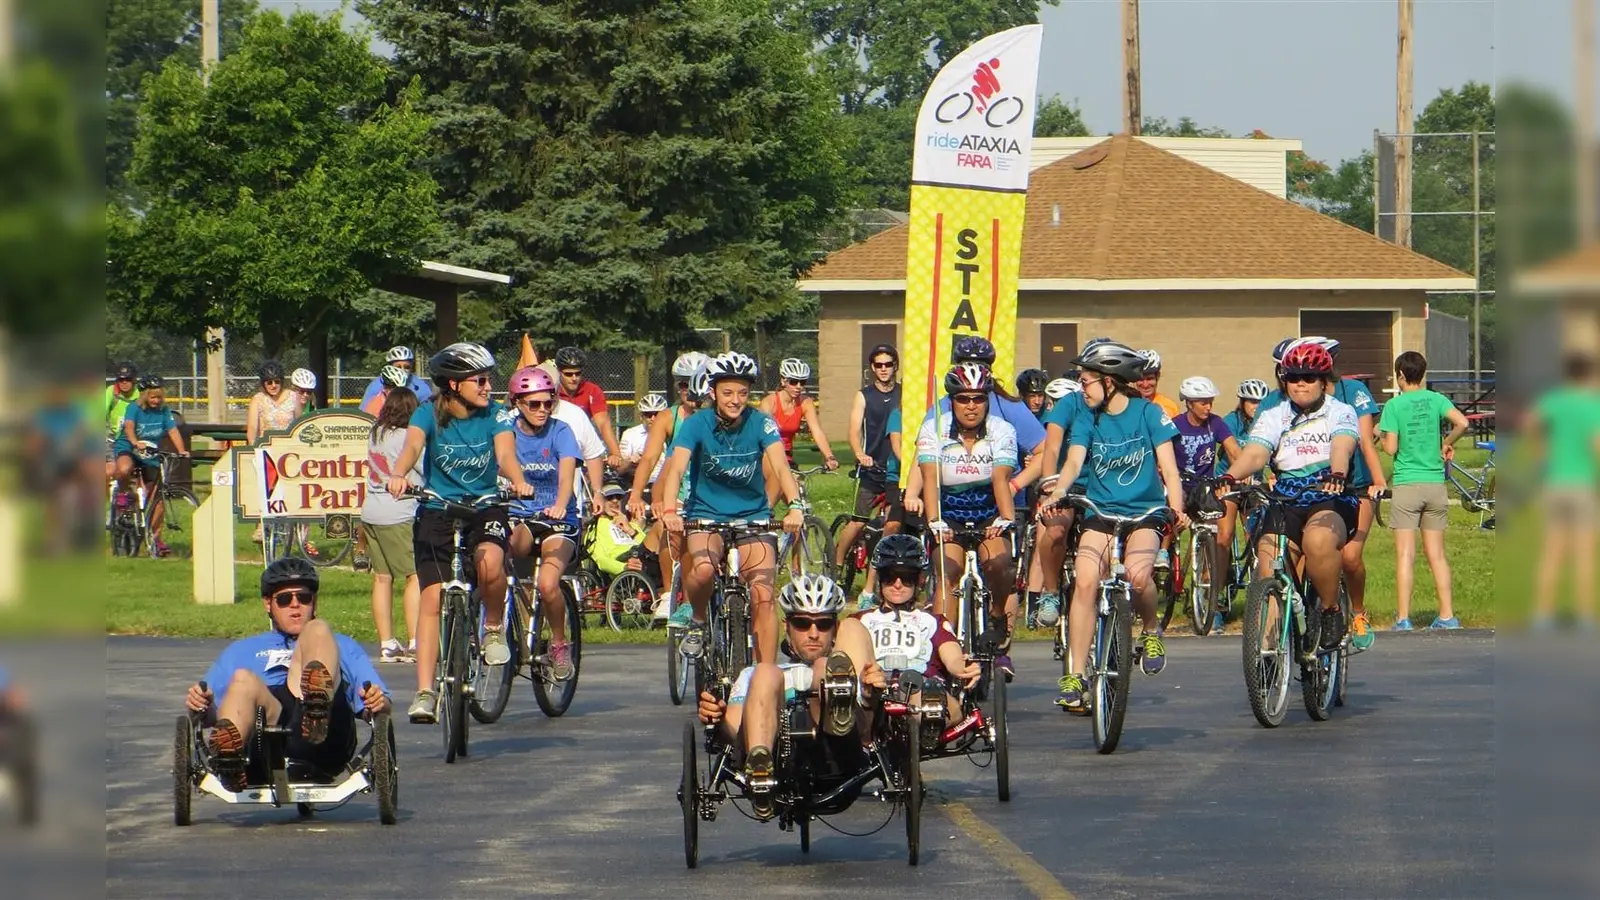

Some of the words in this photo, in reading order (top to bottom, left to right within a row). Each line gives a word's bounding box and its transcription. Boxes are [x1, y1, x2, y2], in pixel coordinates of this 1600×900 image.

[927, 132, 1022, 154] rideATAXIA
[957, 153, 993, 169] FARA
[1296, 446, 1321, 456] FARA
[277, 453, 370, 478] Centr
[955, 465, 980, 475] FARA
[873, 628, 916, 648] 1815
